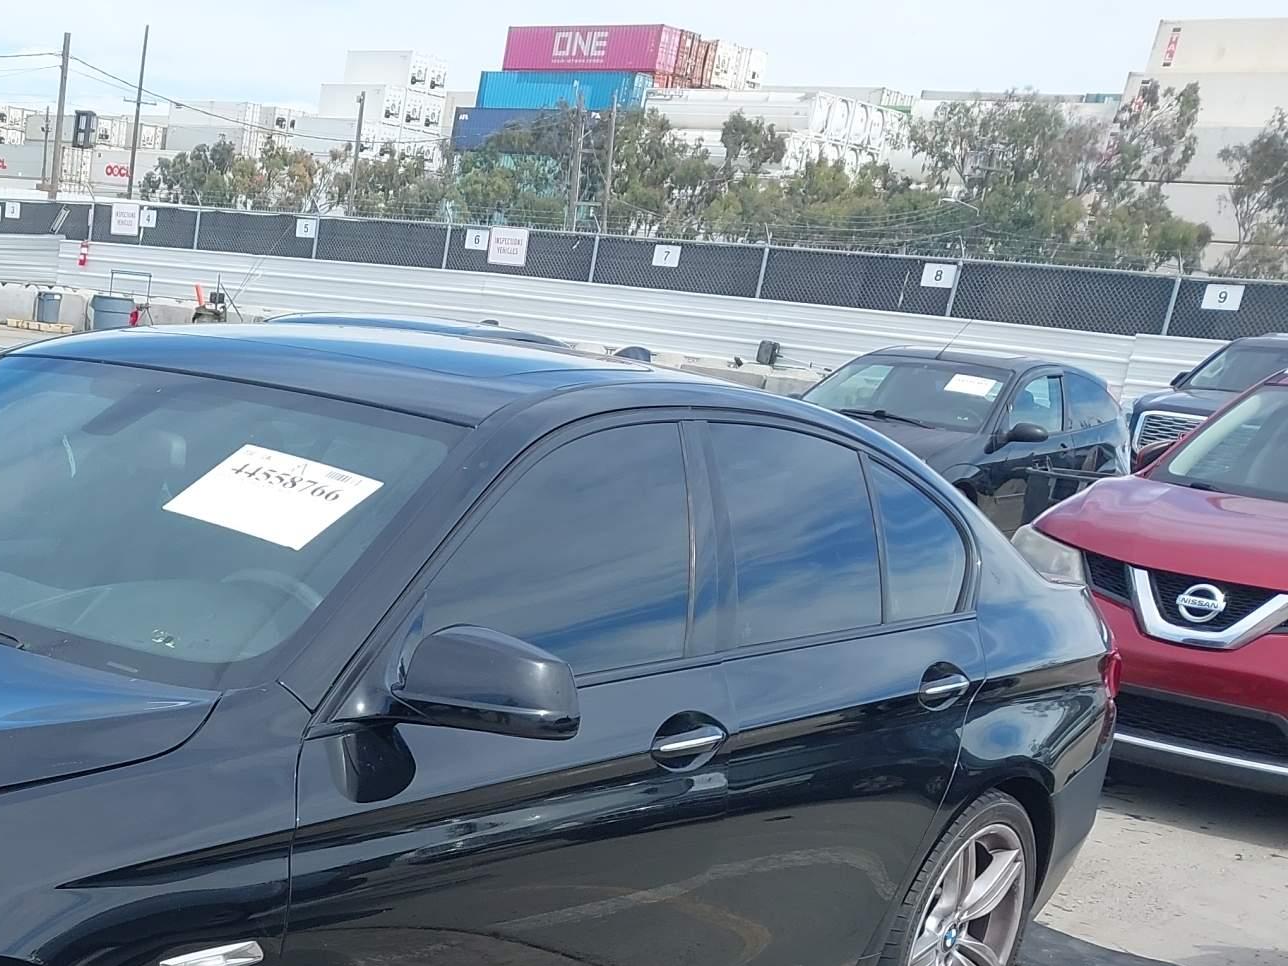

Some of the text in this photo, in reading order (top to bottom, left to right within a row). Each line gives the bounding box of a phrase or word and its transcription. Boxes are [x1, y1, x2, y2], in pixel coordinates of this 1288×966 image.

[552, 31, 609, 57] ONE
[303, 223, 309, 233] 5
[474, 234, 481, 245] 6
[664, 250, 671, 261] 7
[934, 269, 943, 282] 8
[1217, 290, 1228, 304] 9
[231, 463, 345, 501] 44558766
[1181, 597, 1219, 609] NISSAN
